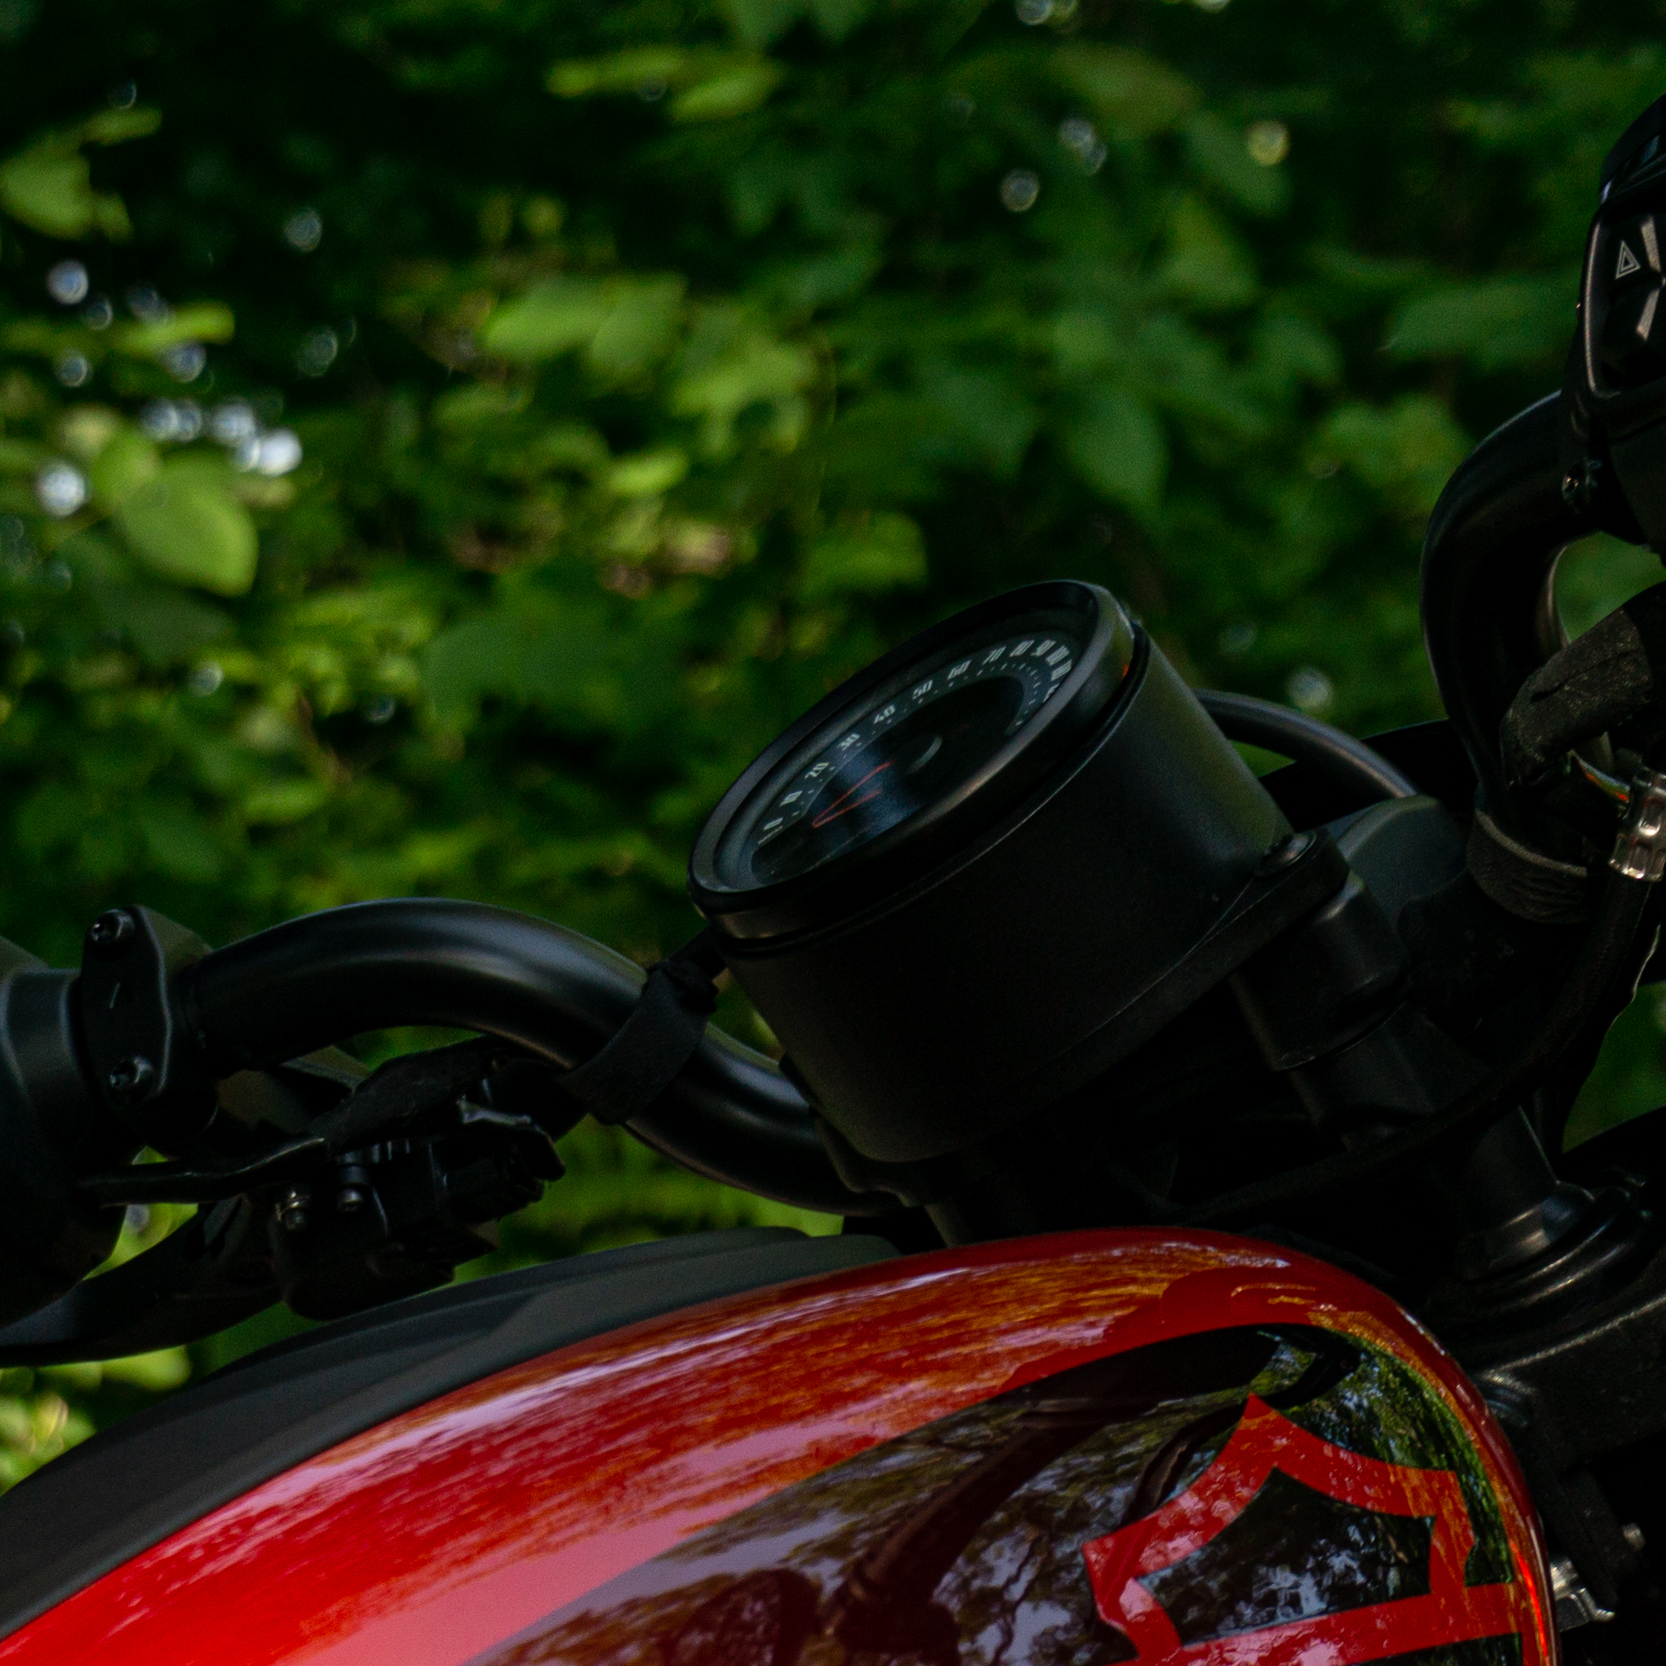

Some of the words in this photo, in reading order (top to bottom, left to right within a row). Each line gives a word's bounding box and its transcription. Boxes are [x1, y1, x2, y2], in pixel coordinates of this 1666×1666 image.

[982, 646, 1007, 665] 70
[947, 660, 972, 680] 60
[912, 680, 933, 700] 50
[873, 704, 897, 724] 40
[836, 733, 861, 751] 30
[804, 762, 830, 780] 20
[779, 790, 803, 807] 10
